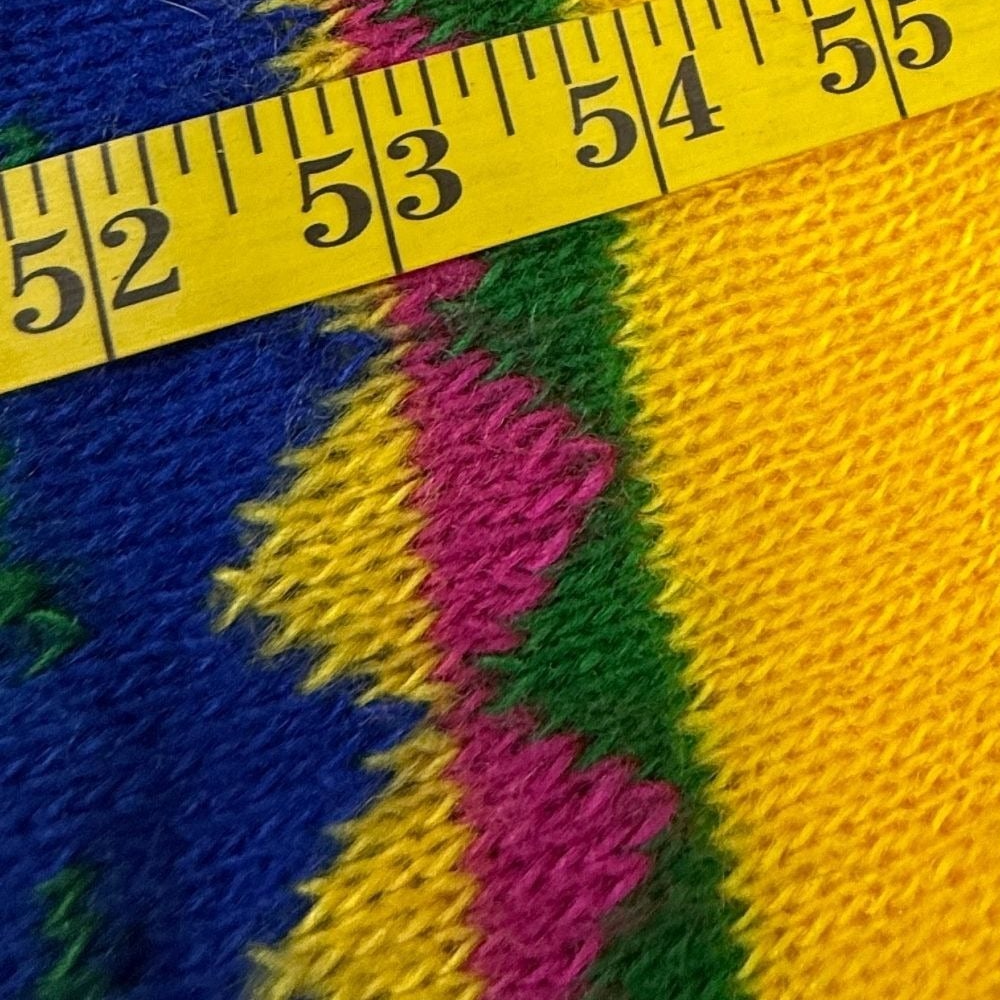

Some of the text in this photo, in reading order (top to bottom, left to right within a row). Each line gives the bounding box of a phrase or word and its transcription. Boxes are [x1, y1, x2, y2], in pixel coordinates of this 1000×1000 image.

[10, 206, 181, 335] 52
[298, 128, 465, 248] 53
[567, 54, 725, 169] 54
